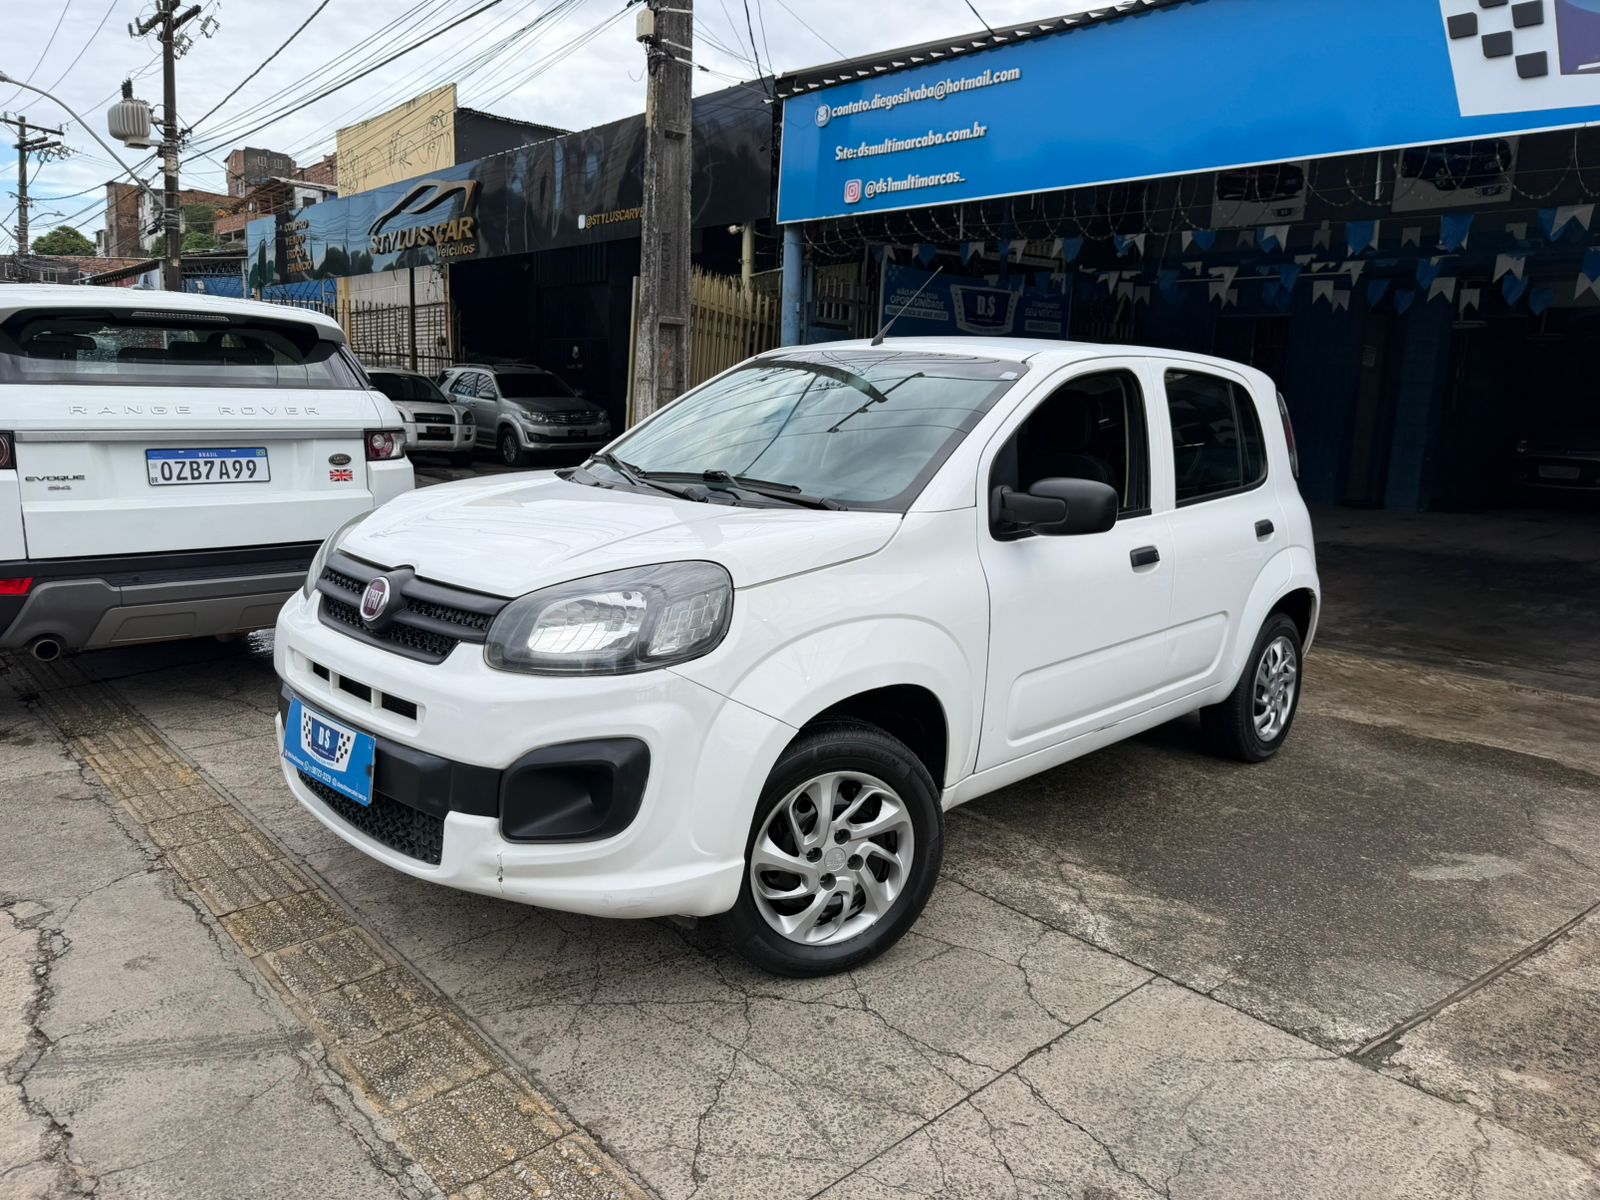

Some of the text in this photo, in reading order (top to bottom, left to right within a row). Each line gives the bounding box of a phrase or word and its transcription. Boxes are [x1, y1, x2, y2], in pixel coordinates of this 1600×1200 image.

[832, 67, 1021, 118] contato.diegosilvaba@hotmail.com
[858, 121, 987, 159] dsmultimarcaba.com.br
[432, 216, 474, 244] CAR
[69, 405, 320, 416] RANGE ROVER
[25, 474, 86, 482] EVOQUE
[160, 459, 257, 481] OZB7A99
[365, 588, 384, 610] FIAT
